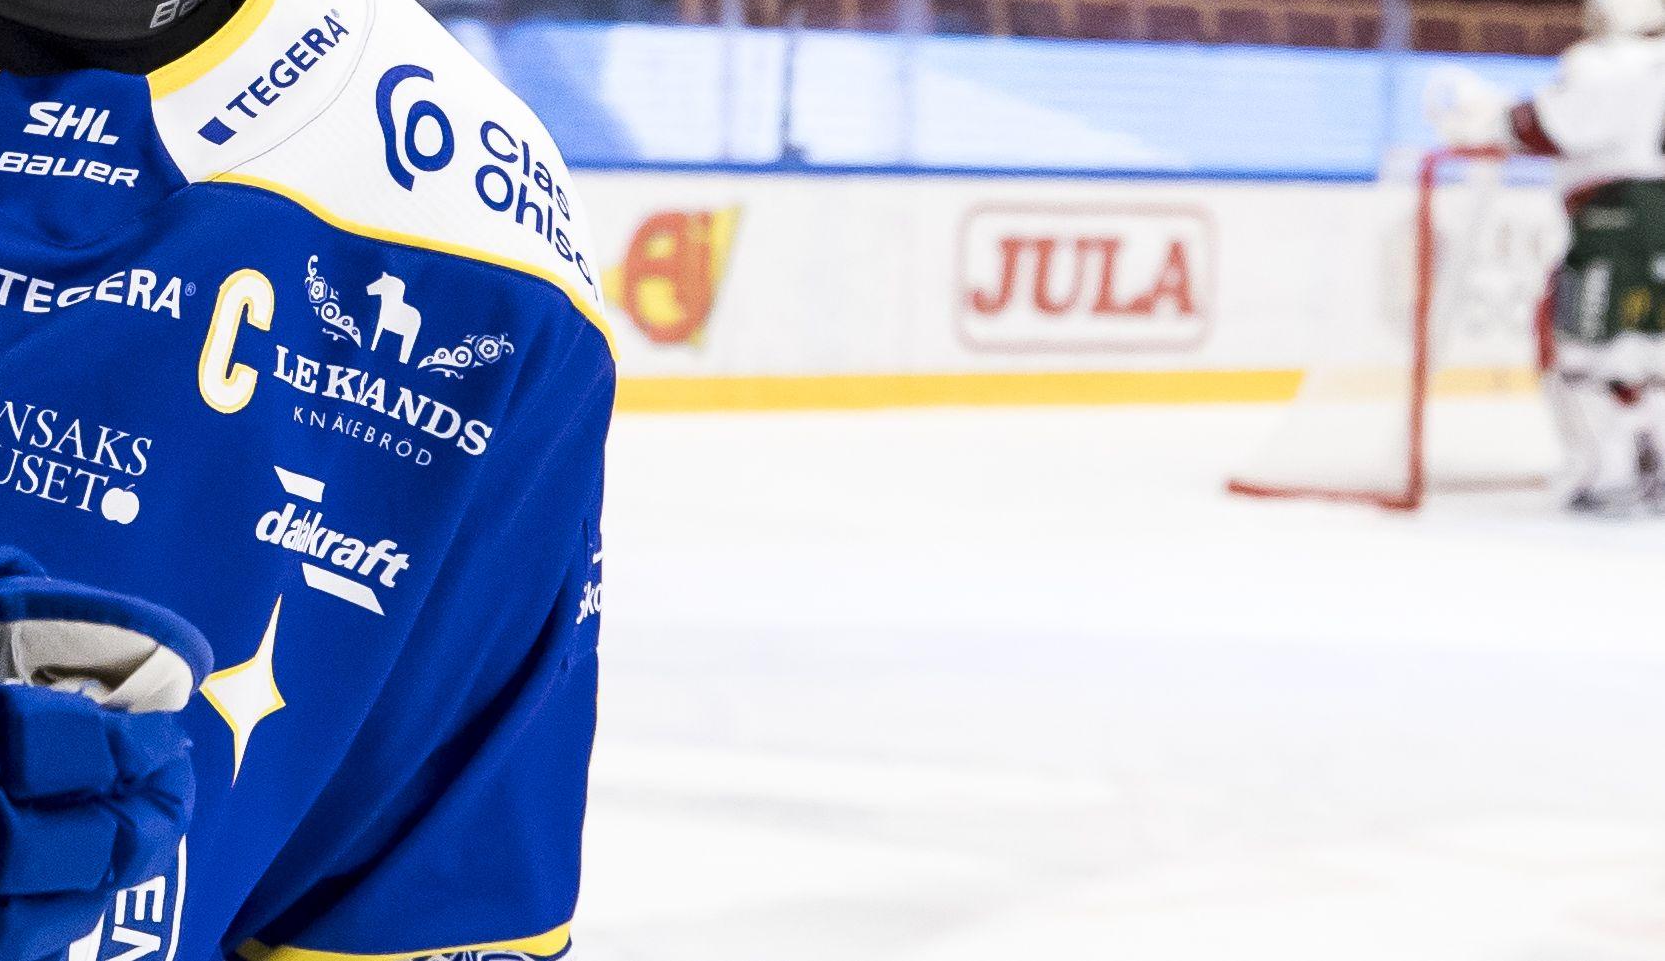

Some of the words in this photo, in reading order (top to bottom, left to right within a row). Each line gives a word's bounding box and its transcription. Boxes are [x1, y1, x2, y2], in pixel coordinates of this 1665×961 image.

[23, 101, 120, 145] SHL
[480, 120, 570, 222] Clas
[970, 236, 1196, 318] JULA
[198, 268, 275, 414] C
